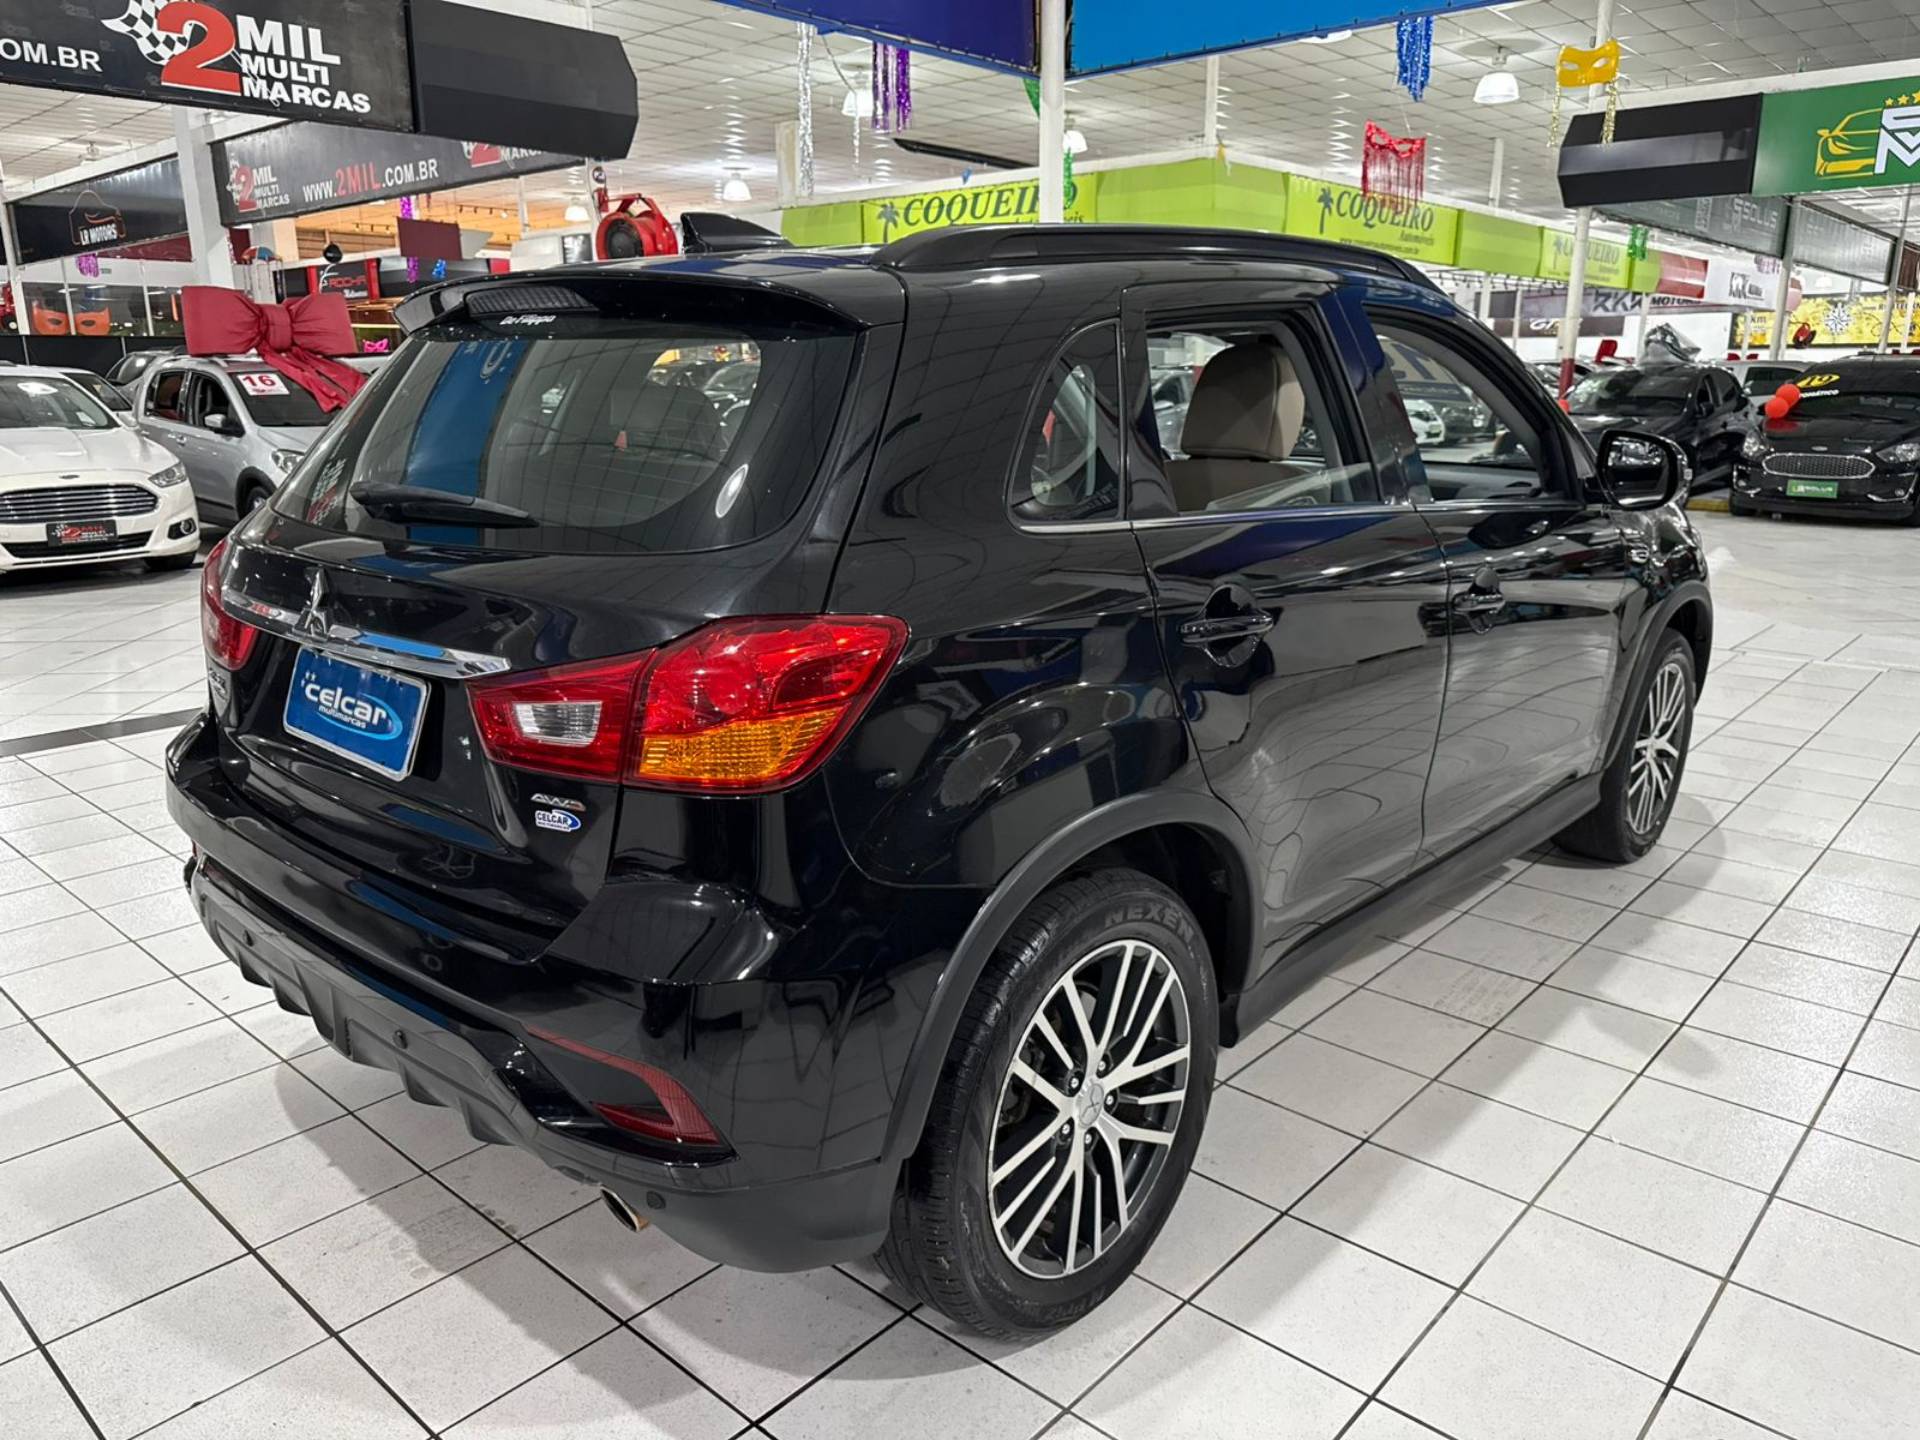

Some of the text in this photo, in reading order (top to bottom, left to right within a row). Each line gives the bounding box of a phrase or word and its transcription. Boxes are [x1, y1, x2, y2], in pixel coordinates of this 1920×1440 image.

[157, 1, 341, 96] 2 MIL
[241, 53, 330, 86] MULTI
[242, 76, 372, 114] MARCAS
[252, 165, 277, 186] MIL
[302, 158, 439, 203] WWW.2MIL.COM.BR
[1336, 190, 1434, 230] COQUEIRO
[242, 375, 277, 387] 16
[304, 682, 388, 726] celcar
[318, 704, 367, 730] multimarcas
[536, 811, 570, 826] CELCAR
[1103, 901, 1194, 944] NEXEN
